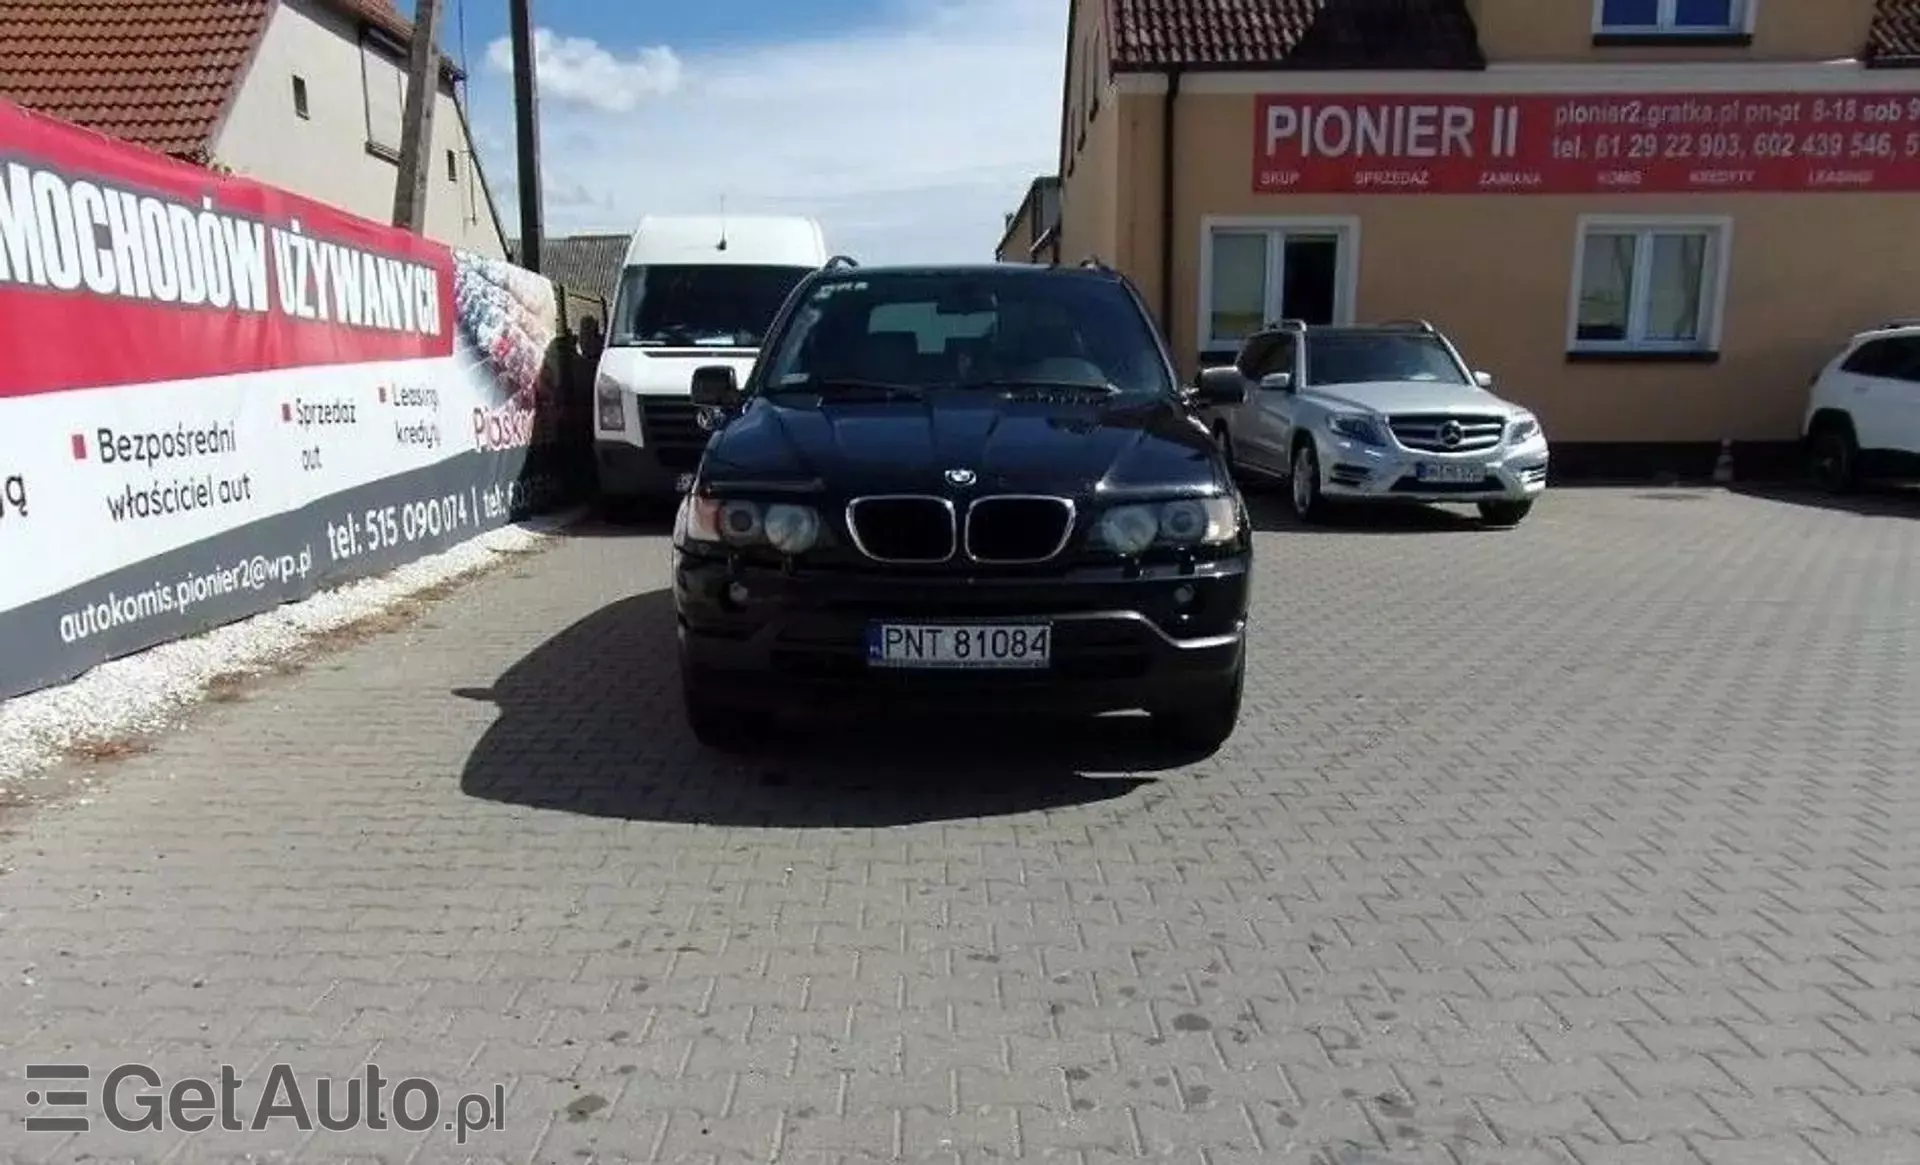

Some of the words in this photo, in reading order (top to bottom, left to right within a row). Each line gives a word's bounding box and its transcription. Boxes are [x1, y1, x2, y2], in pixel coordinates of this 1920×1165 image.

[1266, 105, 1475, 157] PIONIER
[1492, 105, 1519, 158] II
[1812, 99, 1857, 121] 8-18
[1862, 99, 1901, 121] sob
[1595, 135, 1621, 158] 61
[1627, 134, 1658, 157] 29
[1664, 134, 1693, 157] 22
[1753, 133, 1795, 156] 602
[1801, 133, 1843, 156] 439
[1261, 172, 1300, 185] SKUP
[0, 162, 269, 313] MOCHODÓW
[271, 218, 441, 336] UŻYWANYCH
[97, 420, 237, 467] Bezpośredni
[107, 473, 215, 522] właściciel
[218, 472, 252, 504] aut
[327, 512, 362, 561] tel:
[365, 505, 399, 550] 515
[402, 499, 441, 541] 090
[442, 492, 467, 533] 074
[482, 482, 507, 519] tel:
[59, 543, 312, 643] autokomis.pionier2@wp.pl
[885, 628, 943, 658] PNT
[954, 629, 1050, 659] 81084
